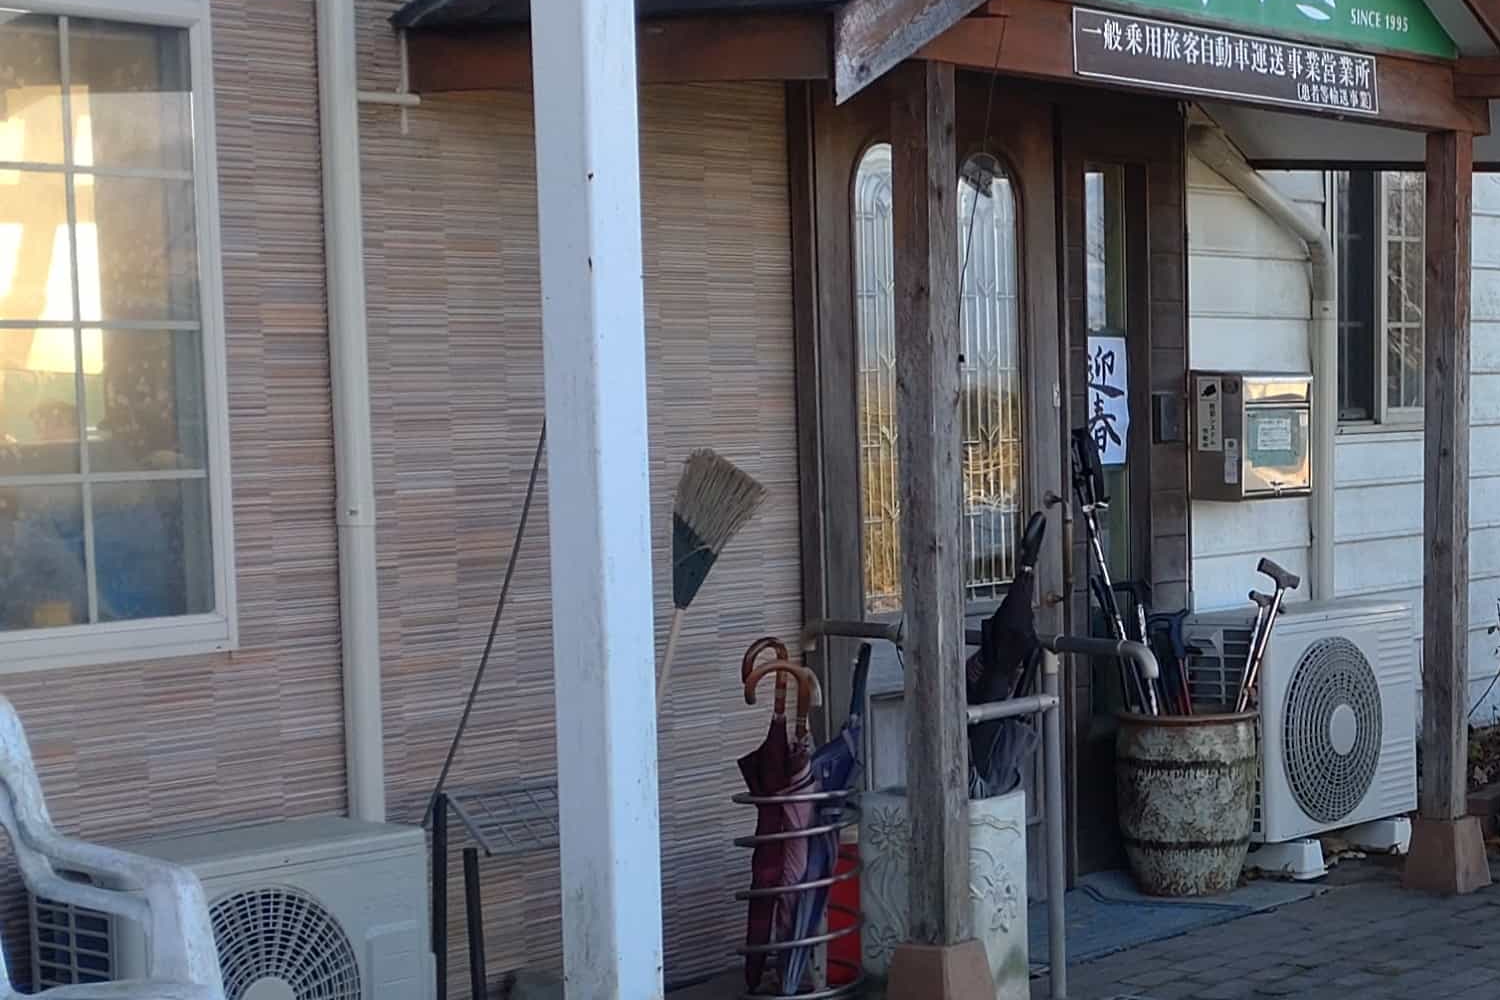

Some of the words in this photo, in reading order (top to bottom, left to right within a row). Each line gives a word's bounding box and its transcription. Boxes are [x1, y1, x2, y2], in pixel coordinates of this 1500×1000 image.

[1081, 18, 1371, 89] 一般乗用旅客自動車運送事業営業所
[1350, 8, 1382, 30] SINCE
[1384, 13, 1409, 33] 1995
[1087, 345, 1125, 453] 迎春
